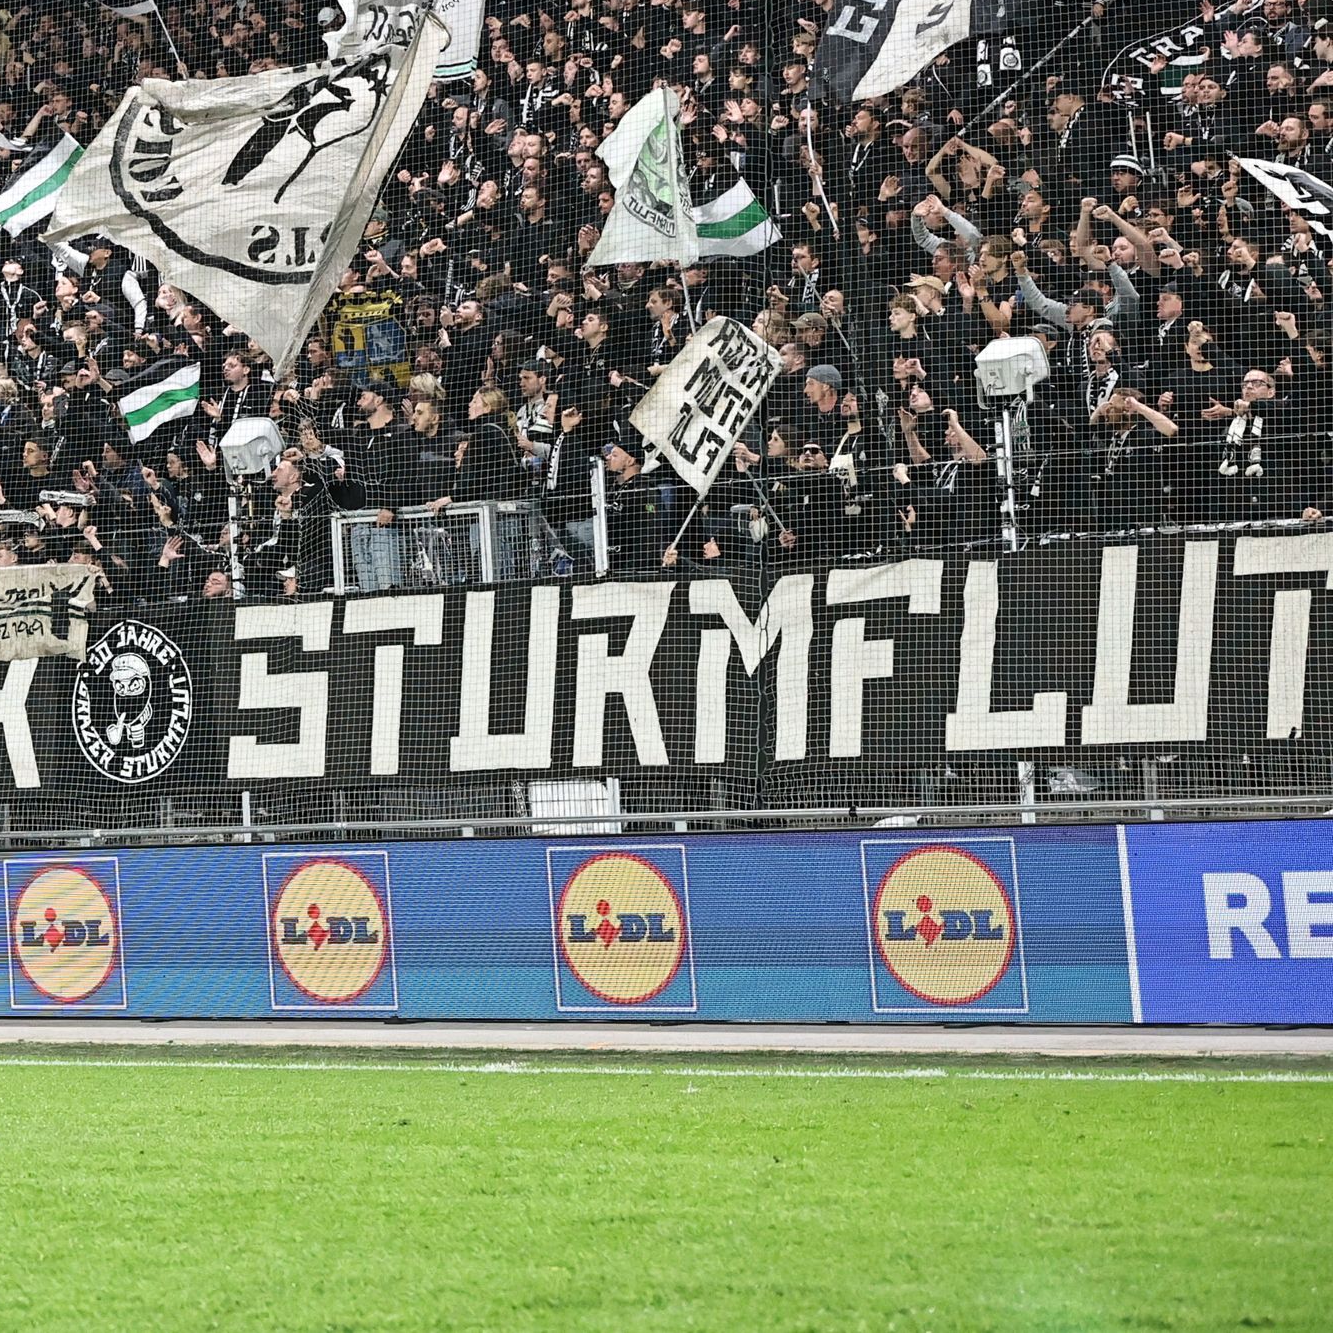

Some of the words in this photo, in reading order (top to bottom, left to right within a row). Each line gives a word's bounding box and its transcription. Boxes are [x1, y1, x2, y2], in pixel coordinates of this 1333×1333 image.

[117, 624, 176, 666] JAHRE
[228, 533, 1333, 779] STURMFLUT
[77, 680, 116, 770] GRAZER
[121, 674, 191, 778] STURMFLUT
[1202, 871, 1333, 960] RE
